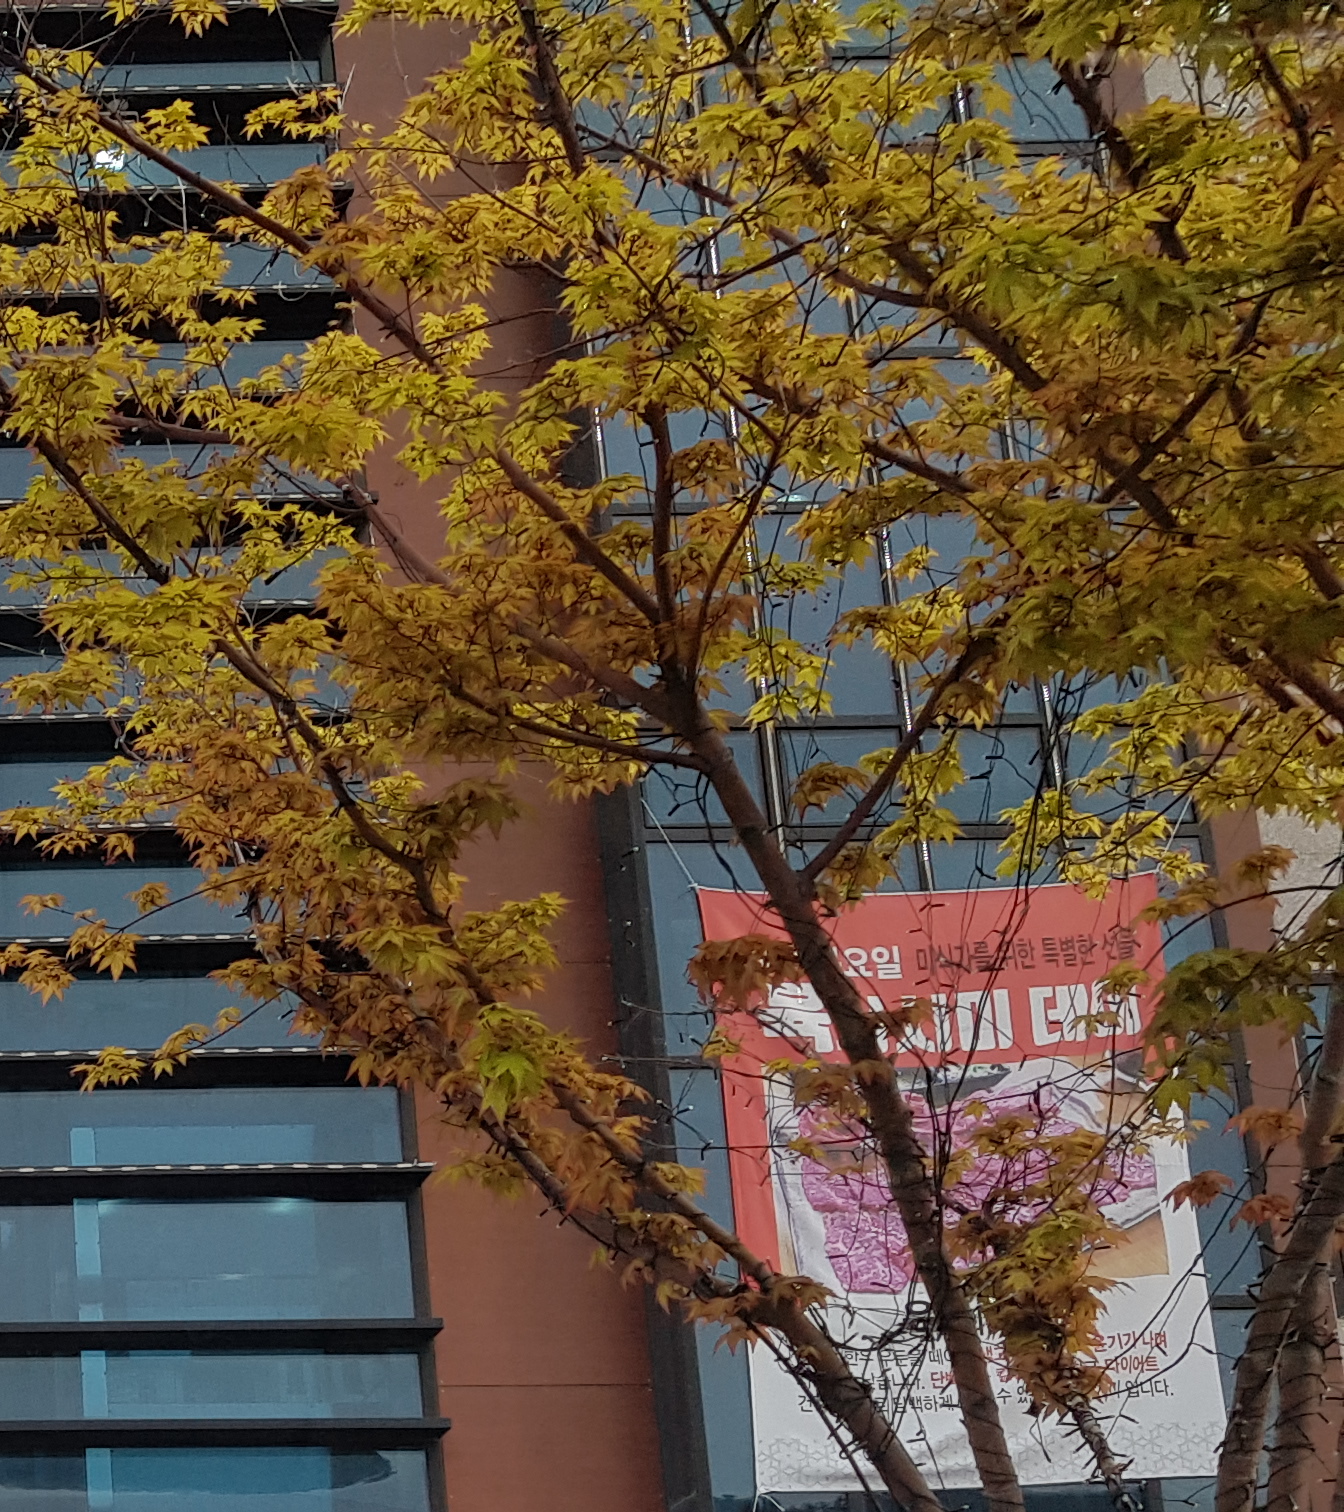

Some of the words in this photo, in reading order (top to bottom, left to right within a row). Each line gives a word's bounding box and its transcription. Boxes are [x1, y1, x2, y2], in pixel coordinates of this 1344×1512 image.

[832, 945, 903, 980] 요일
[1041, 934, 1096, 967] 특별한
[1105, 1356, 1160, 1372] 다이어트
